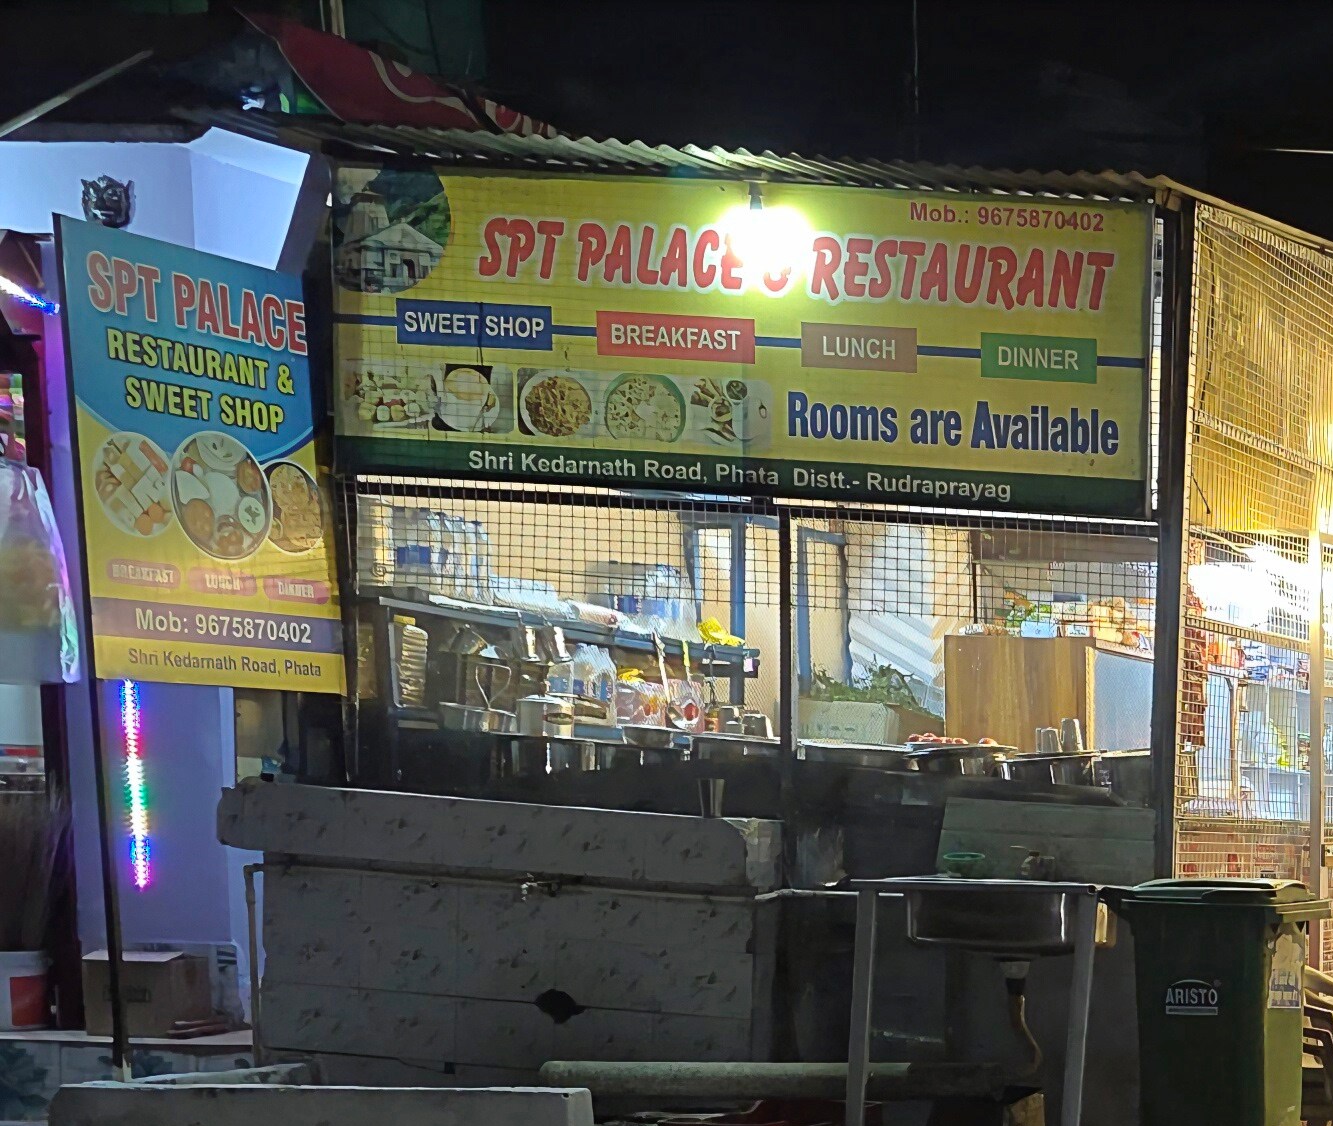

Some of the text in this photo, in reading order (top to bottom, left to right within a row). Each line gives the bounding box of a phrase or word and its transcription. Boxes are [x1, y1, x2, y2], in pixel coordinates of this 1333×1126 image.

[977, 206, 1104, 232] 9675870402
[478, 216, 565, 280] SPT
[810, 237, 1115, 311] RESTAURANT
[86, 250, 308, 356] SPT PALACE
[404, 311, 545, 339] SWEET SHOP
[610, 323, 741, 351] BREAKFAST
[107, 327, 295, 395] RESTAURANT &
[821, 335, 897, 361] LUNCH
[998, 346, 1079, 371] DINNER
[125, 376, 285, 433] SWEET SHOP
[787, 391, 1120, 456] Rooms are Available
[468, 450, 514, 471] Shri
[521, 453, 637, 477] Kedarnath
[644, 459, 708, 484] Road,
[715, 463, 779, 485] Phata
[867, 472, 1011, 502] Rudraprayag
[135, 608, 311, 643] Mob: 9675870402
[128, 648, 321, 676] Shri Kedarnath Road, Phata
[1165, 988, 1218, 1005] ARISTO
